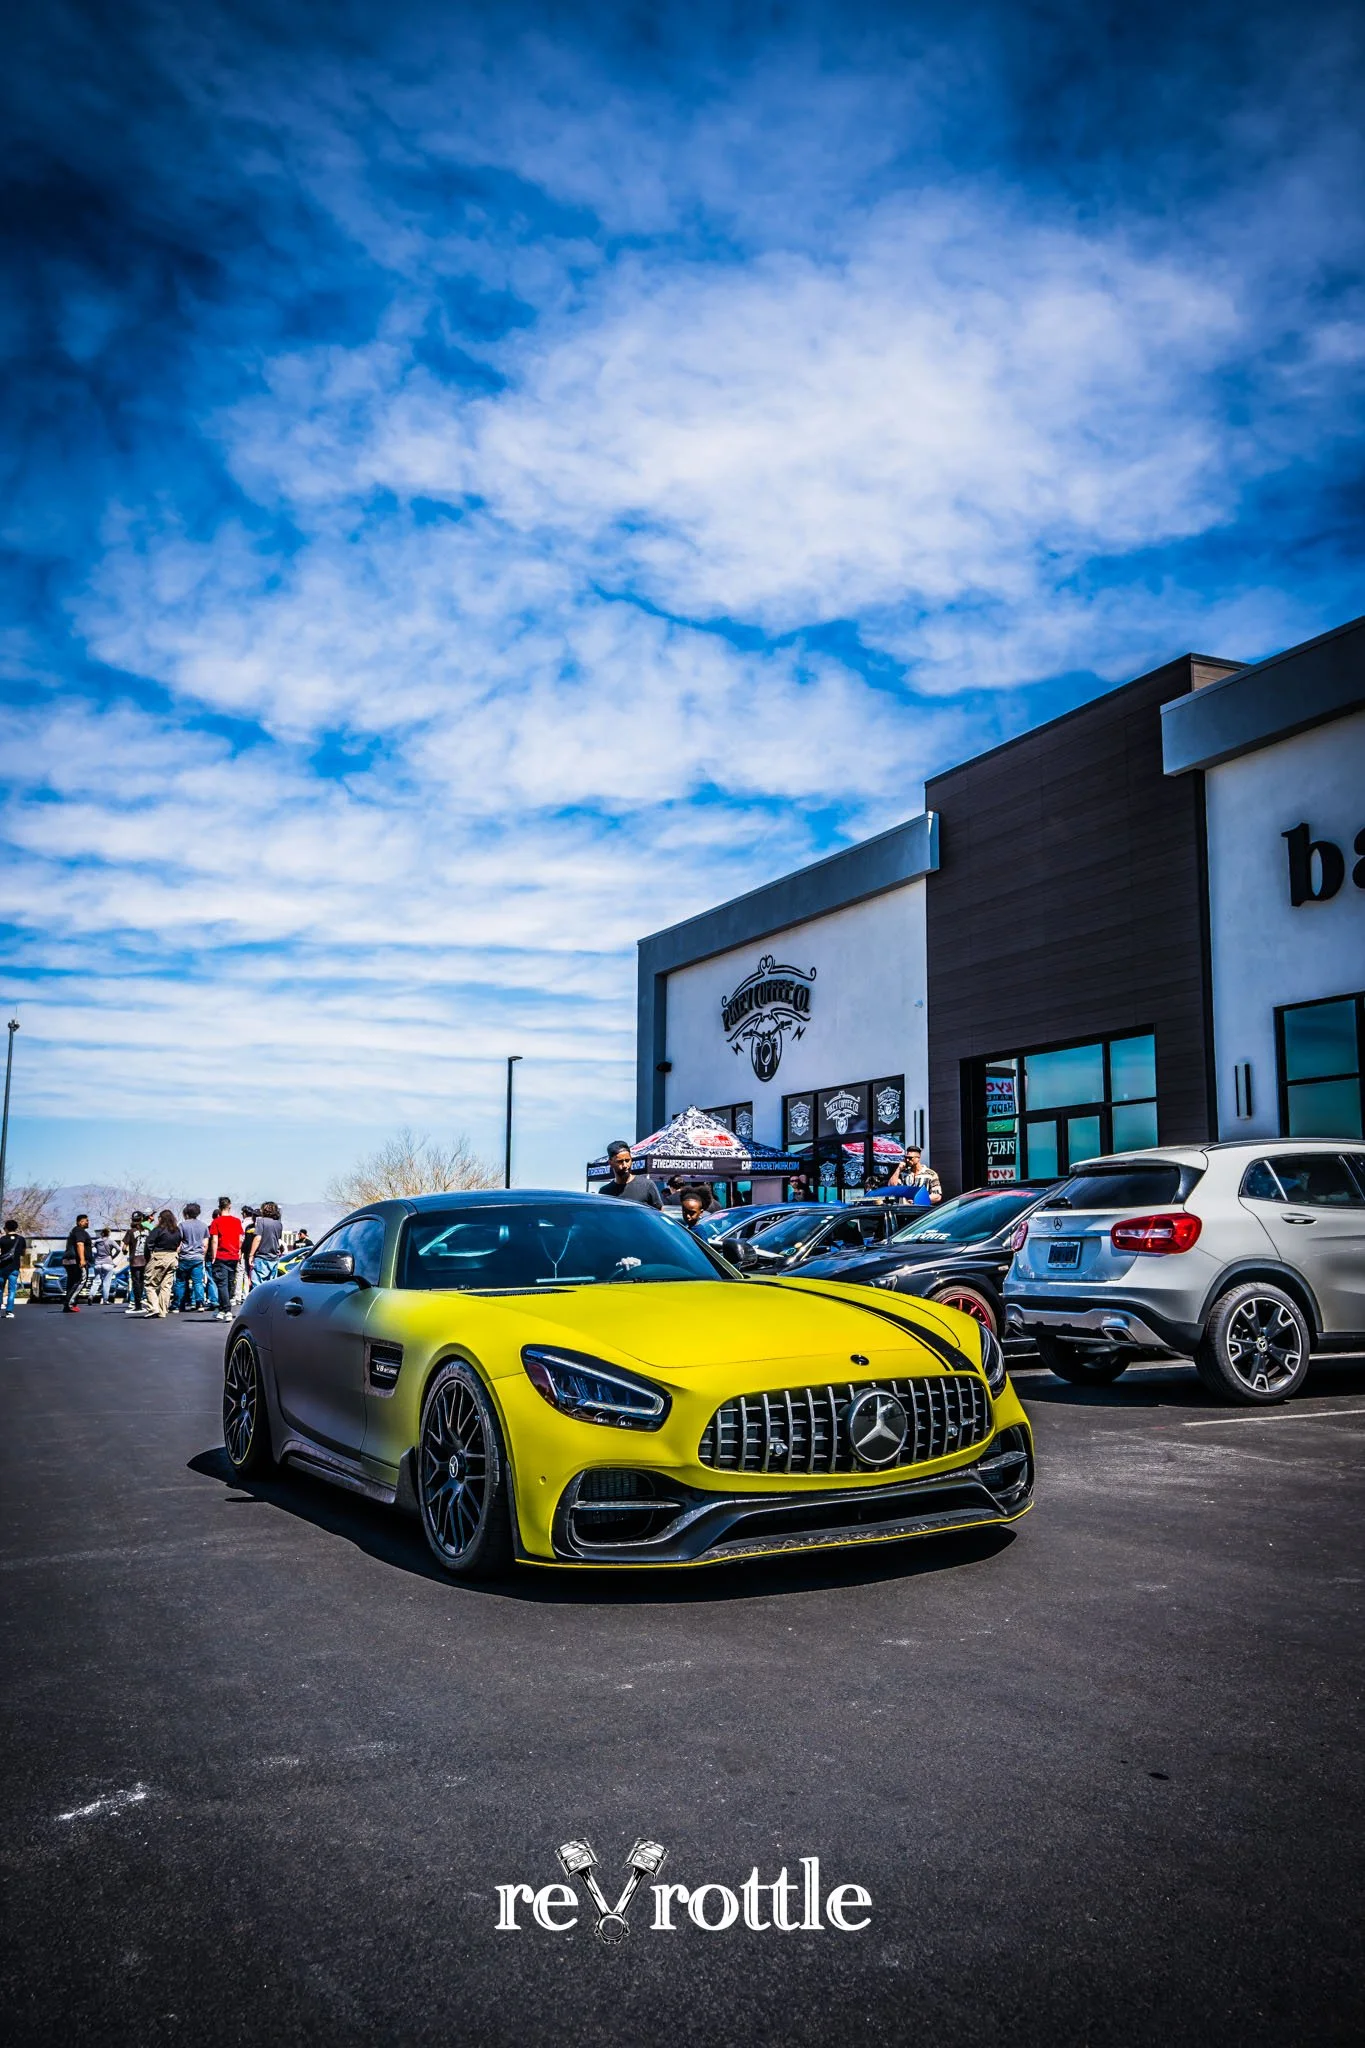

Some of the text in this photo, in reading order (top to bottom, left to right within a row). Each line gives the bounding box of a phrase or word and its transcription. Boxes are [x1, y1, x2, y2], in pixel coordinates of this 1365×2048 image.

[1281, 822, 1365, 908] b
[721, 987, 754, 1032] PIKEY
[753, 979, 795, 1009] COFFEE
[825, 1104, 839, 1117] PIKEY
[838, 1099, 853, 1110] COFFEE
